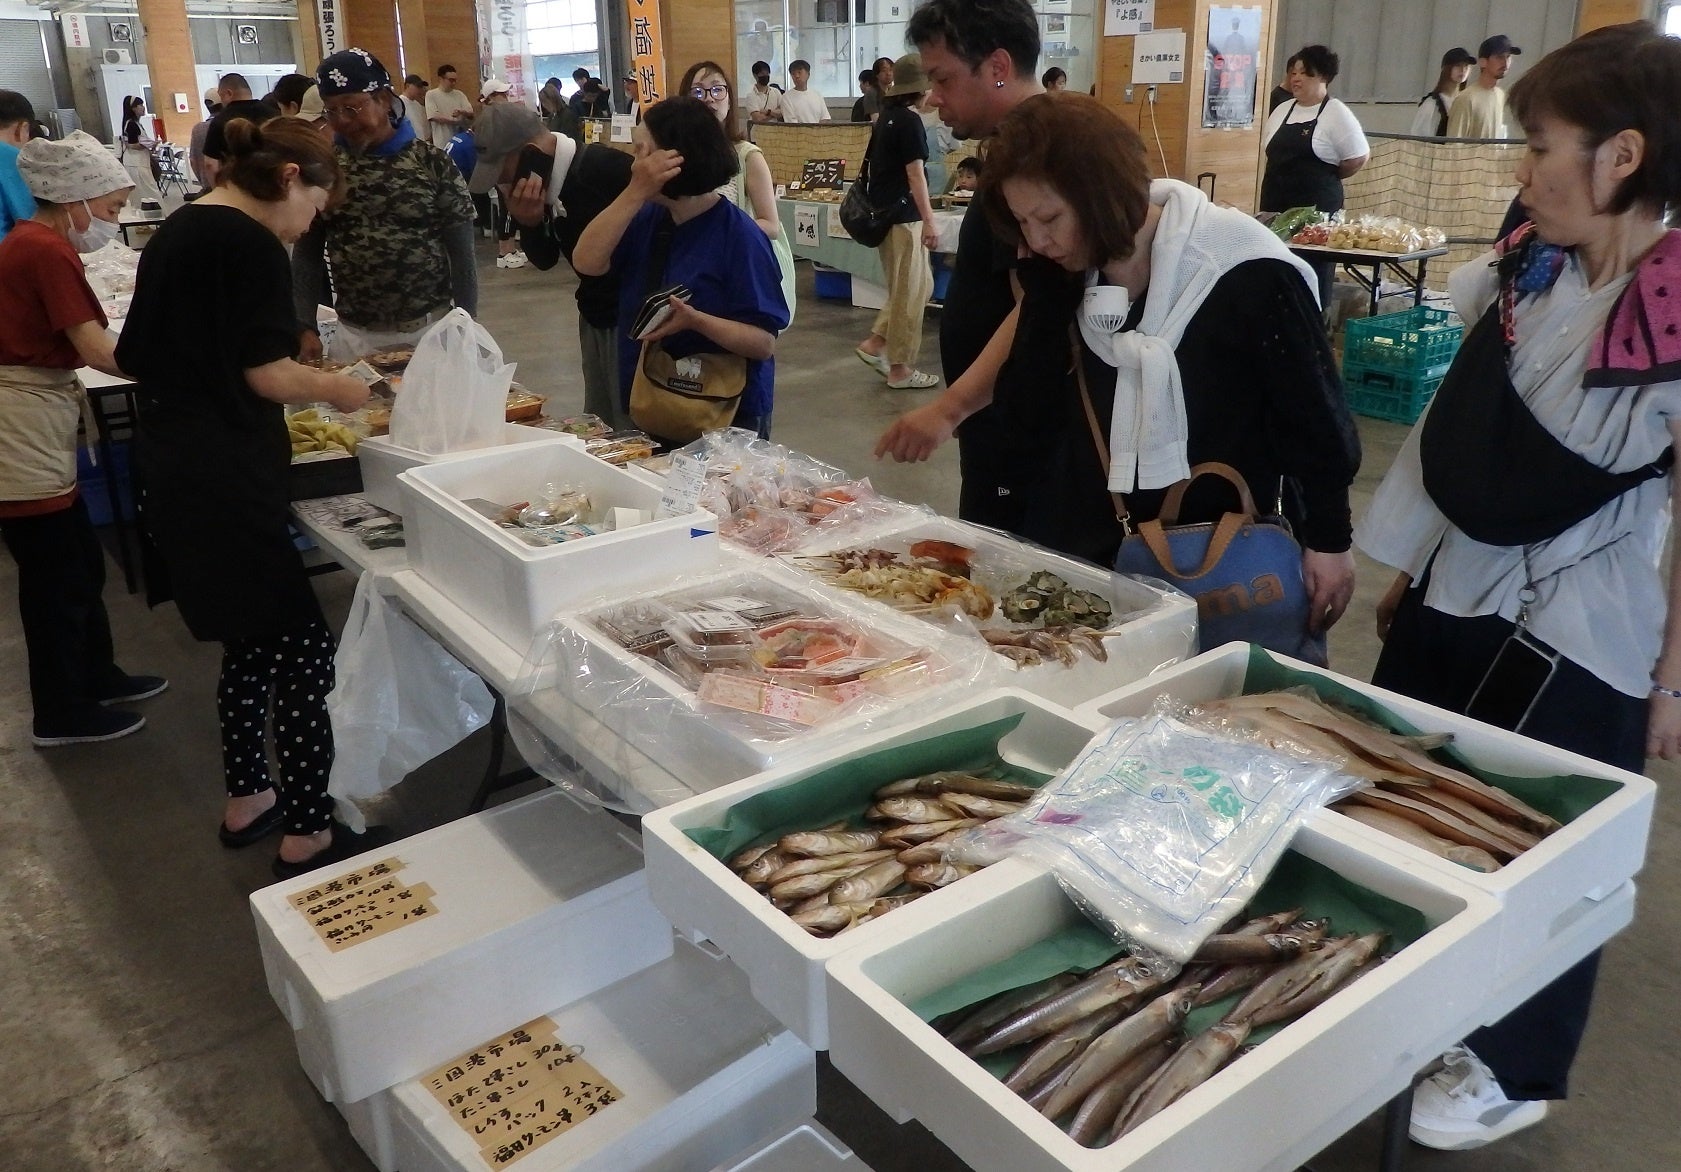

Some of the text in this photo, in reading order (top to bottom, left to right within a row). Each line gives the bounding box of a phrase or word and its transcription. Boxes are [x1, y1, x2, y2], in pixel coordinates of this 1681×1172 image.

[322, 0, 335, 55] 頑張ろう
[296, 863, 391, 906] 三国港市場
[431, 1030, 532, 1090] 三国港市場
